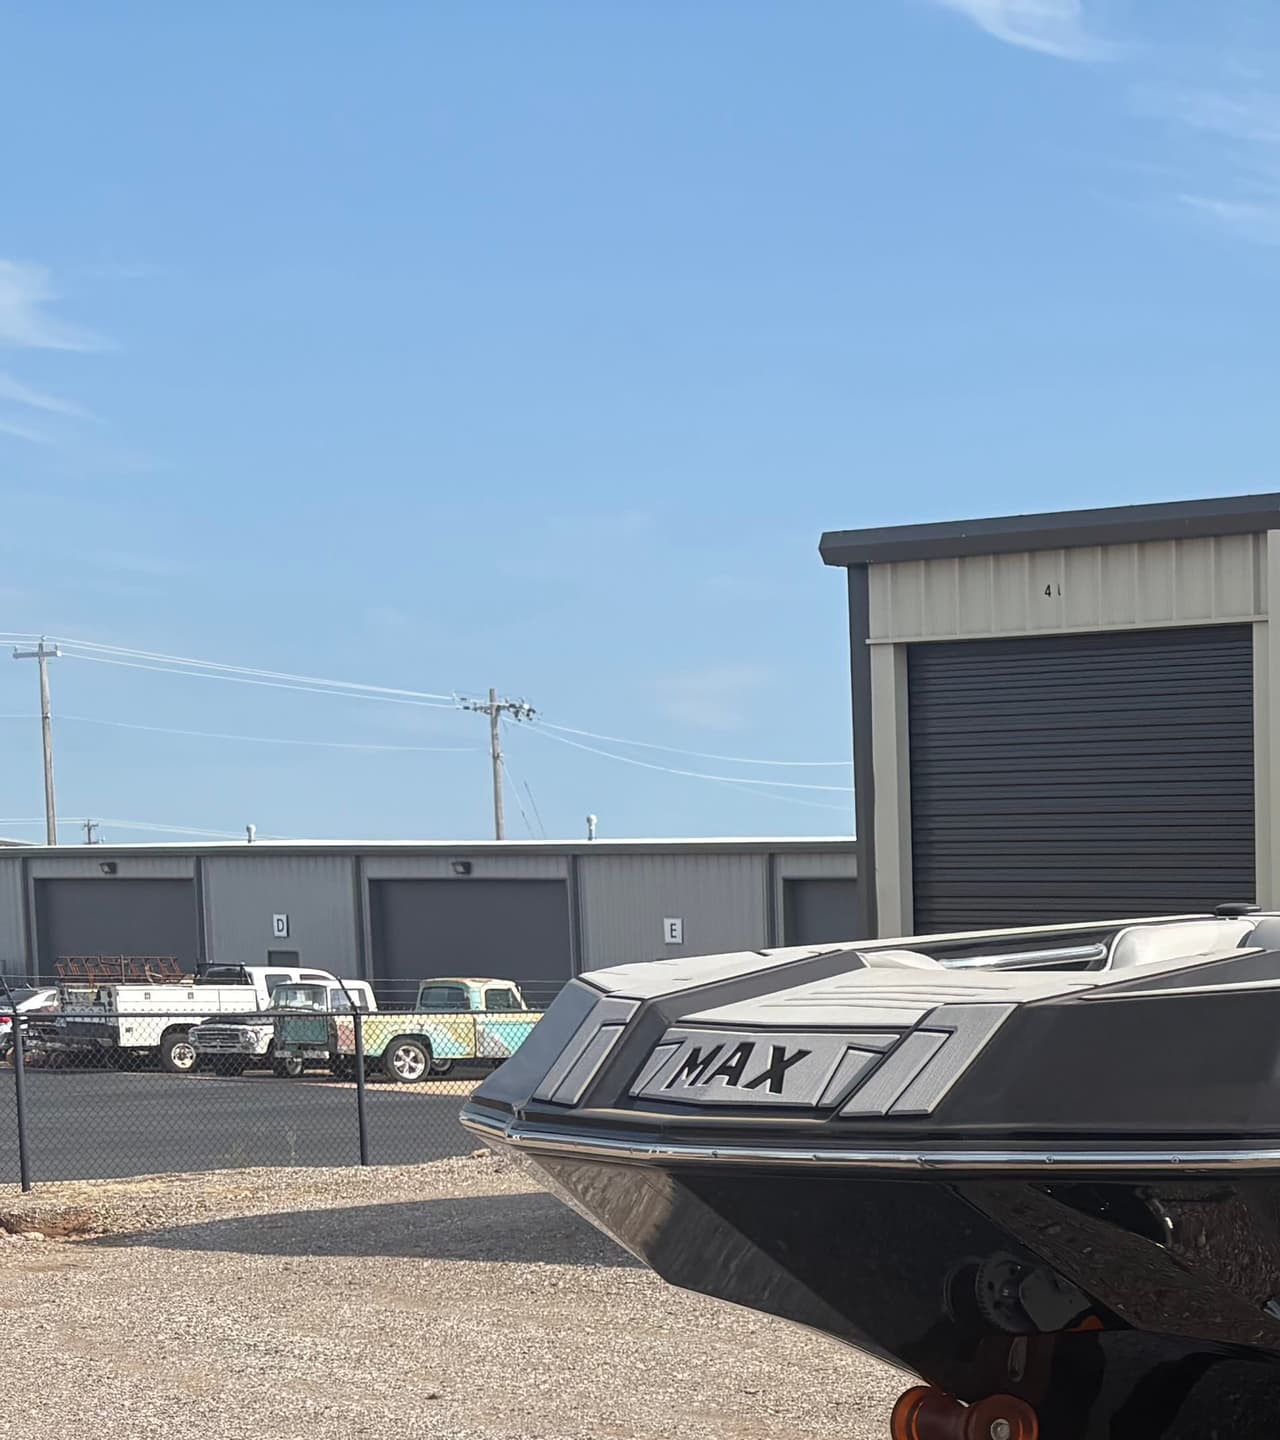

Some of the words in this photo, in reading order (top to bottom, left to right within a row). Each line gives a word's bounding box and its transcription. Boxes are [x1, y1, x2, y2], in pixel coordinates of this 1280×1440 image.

[276, 918, 285, 932] D
[670, 923, 677, 938] E
[661, 1041, 813, 1094] MAX
